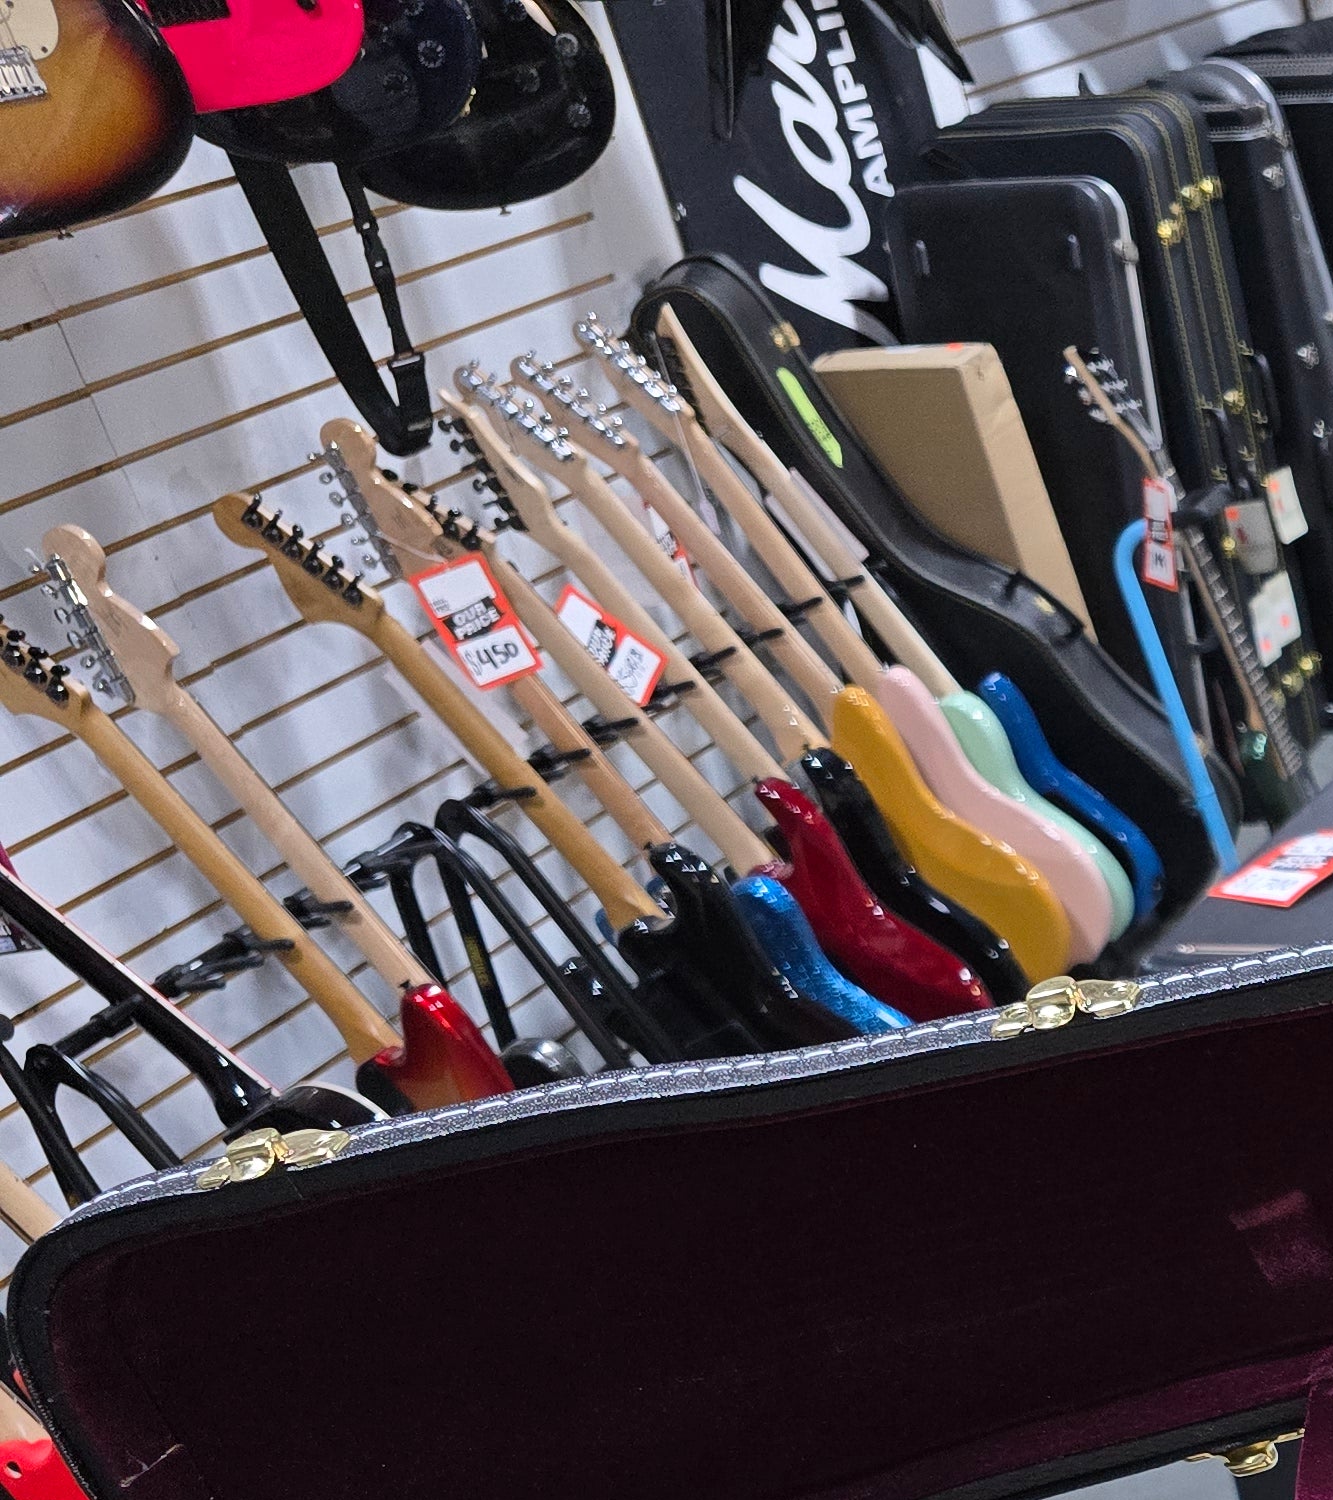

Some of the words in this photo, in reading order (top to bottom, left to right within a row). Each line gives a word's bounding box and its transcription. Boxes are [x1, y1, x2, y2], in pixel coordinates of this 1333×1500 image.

[812, 0, 895, 197] AMPLI
[453, 602, 488, 627] OUR
[454, 608, 501, 641] PRICE
[463, 641, 520, 679] $450
